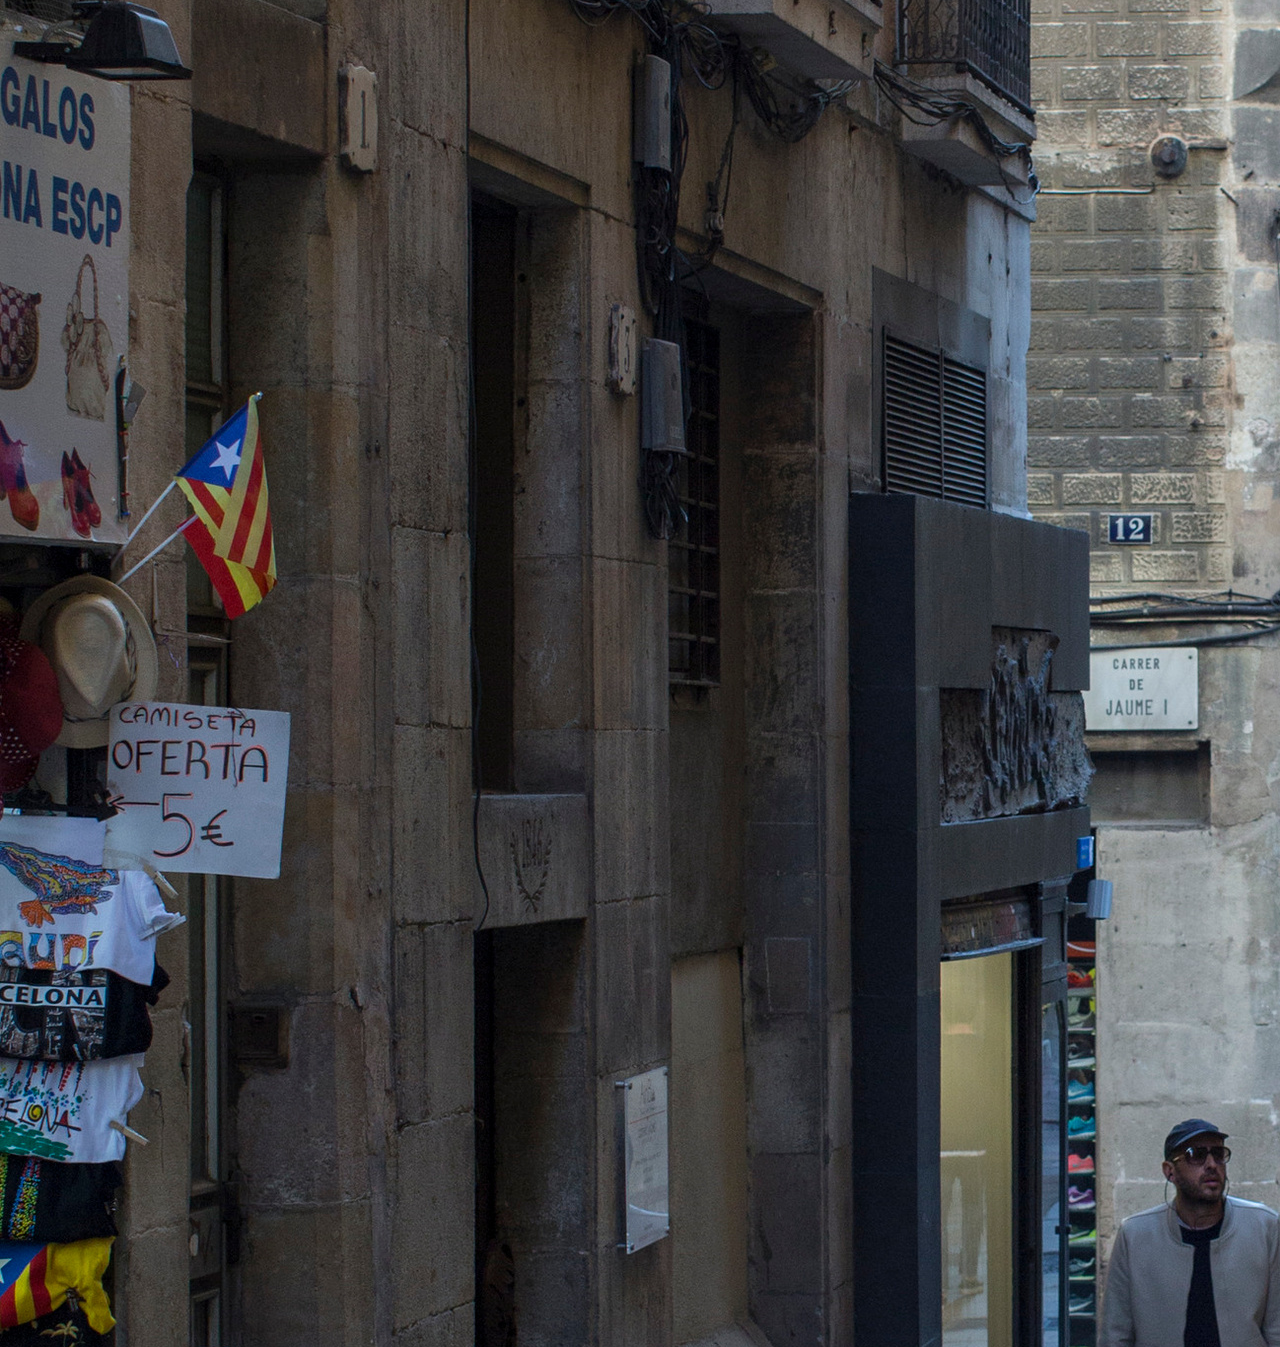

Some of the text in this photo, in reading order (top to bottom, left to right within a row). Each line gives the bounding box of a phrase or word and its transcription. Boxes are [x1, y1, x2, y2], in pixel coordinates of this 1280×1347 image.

[52, 175, 122, 248] ESCP
[1115, 517, 1145, 541] 12
[1112, 657, 1161, 671] CARRER
[1128, 678, 1144, 691] DE
[1105, 698, 1154, 716] JAUME
[118, 705, 256, 738] CAMISETA
[112, 739, 269, 784] OFERTA
[0, 985, 104, 1006] CELONA
